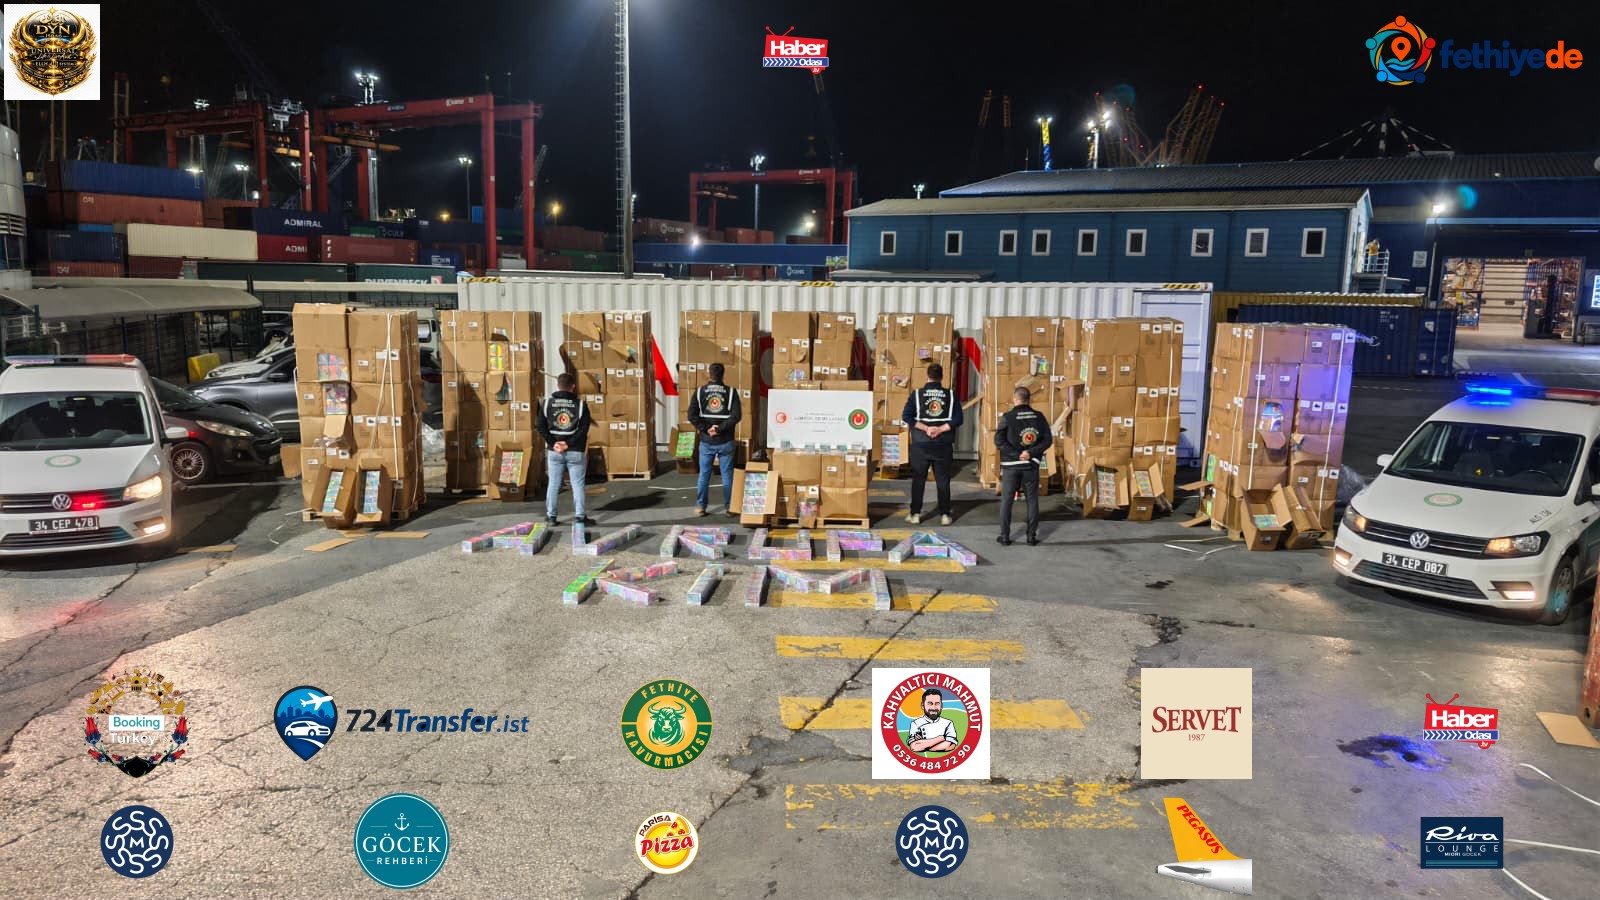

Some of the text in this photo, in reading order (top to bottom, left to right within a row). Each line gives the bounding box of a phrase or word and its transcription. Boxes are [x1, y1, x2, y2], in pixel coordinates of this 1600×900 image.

[284, 218, 323, 228] ADMIRAL
[34, 521, 48, 531] 34
[52, 519, 71, 530] CEP
[1385, 554, 1398, 566] 34
[1401, 557, 1421, 570] CEP
